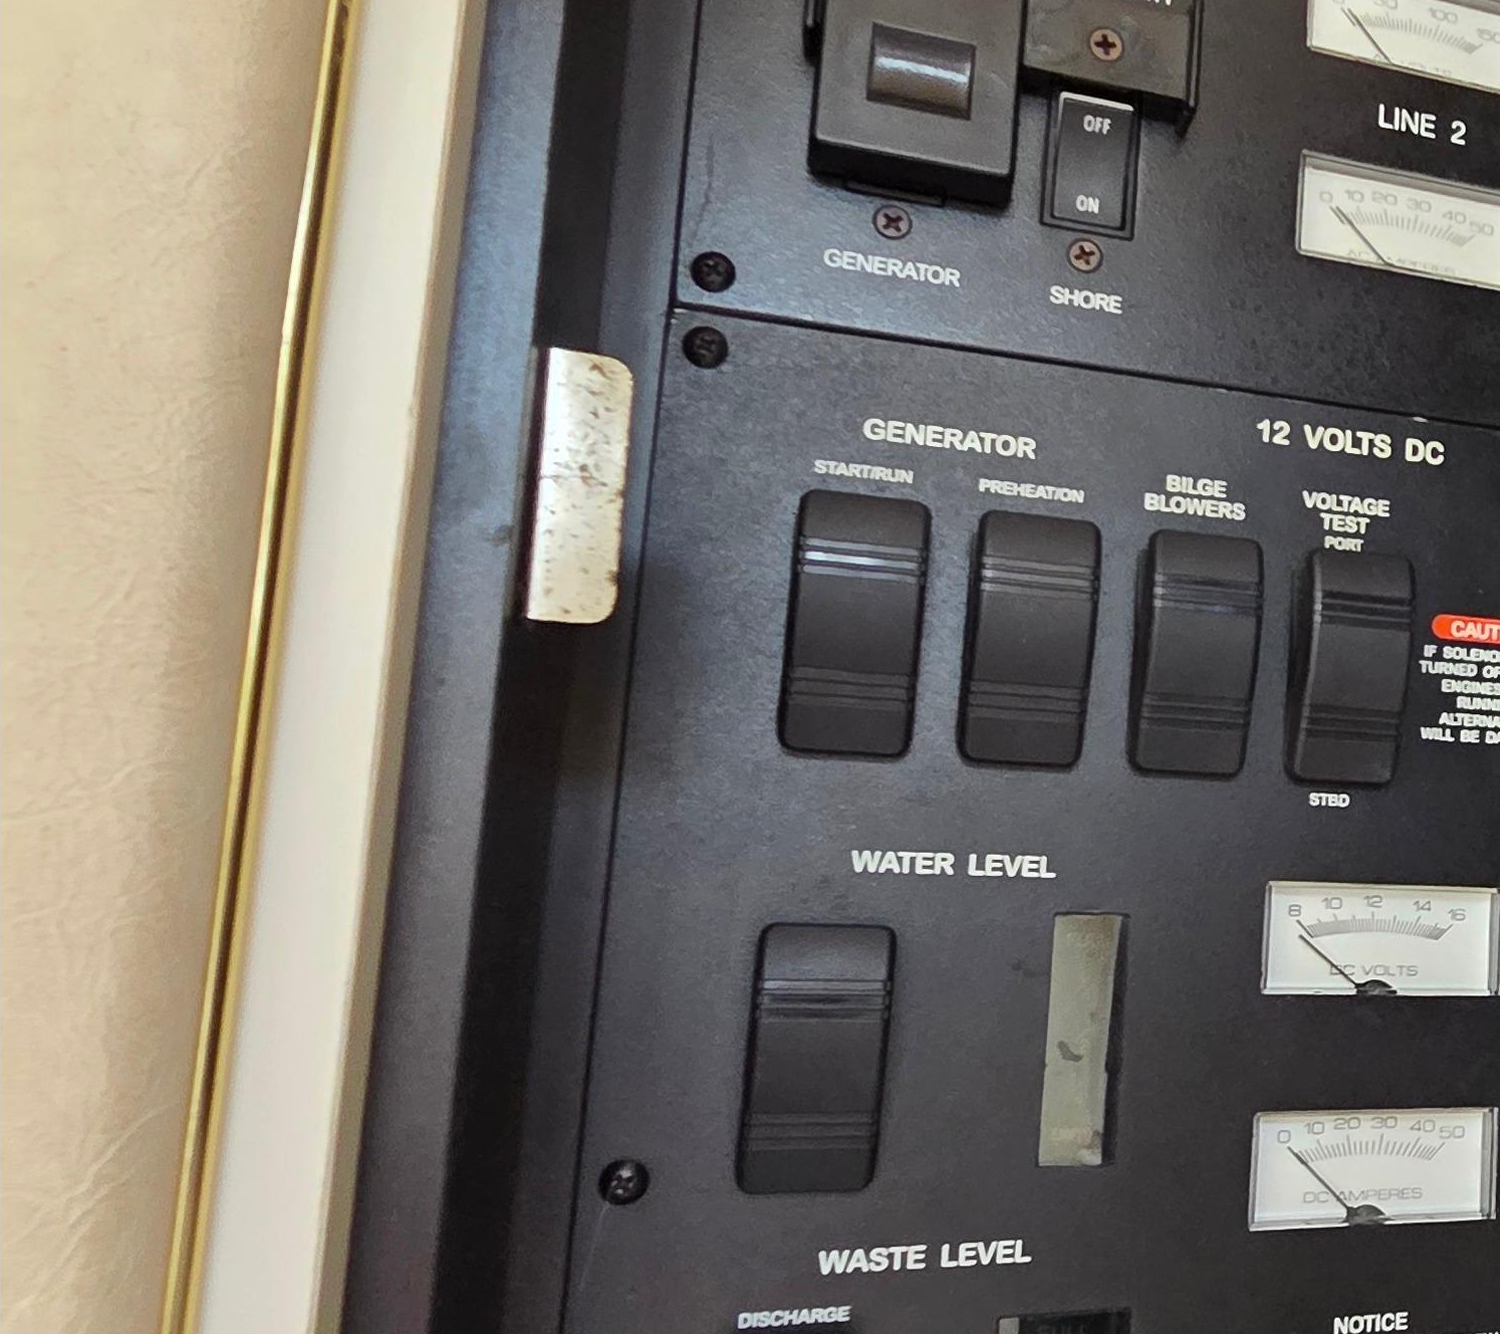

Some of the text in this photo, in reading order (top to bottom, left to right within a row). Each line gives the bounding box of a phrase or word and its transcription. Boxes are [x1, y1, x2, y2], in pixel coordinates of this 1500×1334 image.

[1378, 105, 1466, 145] LINE 2
[824, 249, 960, 287] GENERATOR
[1050, 286, 1122, 314] SHORE
[863, 419, 1036, 459] GENERATOR
[1257, 420, 1444, 465] 12 VOLTS DC
[979, 479, 1084, 503] PREHEATION
[1162, 475, 1227, 498] BILGE
[1144, 493, 1245, 520] BLOWERS
[1302, 490, 1390, 517] VOLTAGE
[1320, 513, 1370, 534] TEST
[1324, 536, 1364, 552] PORT
[1309, 793, 1350, 807] STBD
[851, 850, 1056, 878] WATER LEVEL
[819, 1241, 1031, 1275] WASTE LEVEL
[738, 1306, 852, 1329] DISCHARGE
[1334, 1312, 1408, 1334] NOTICE
